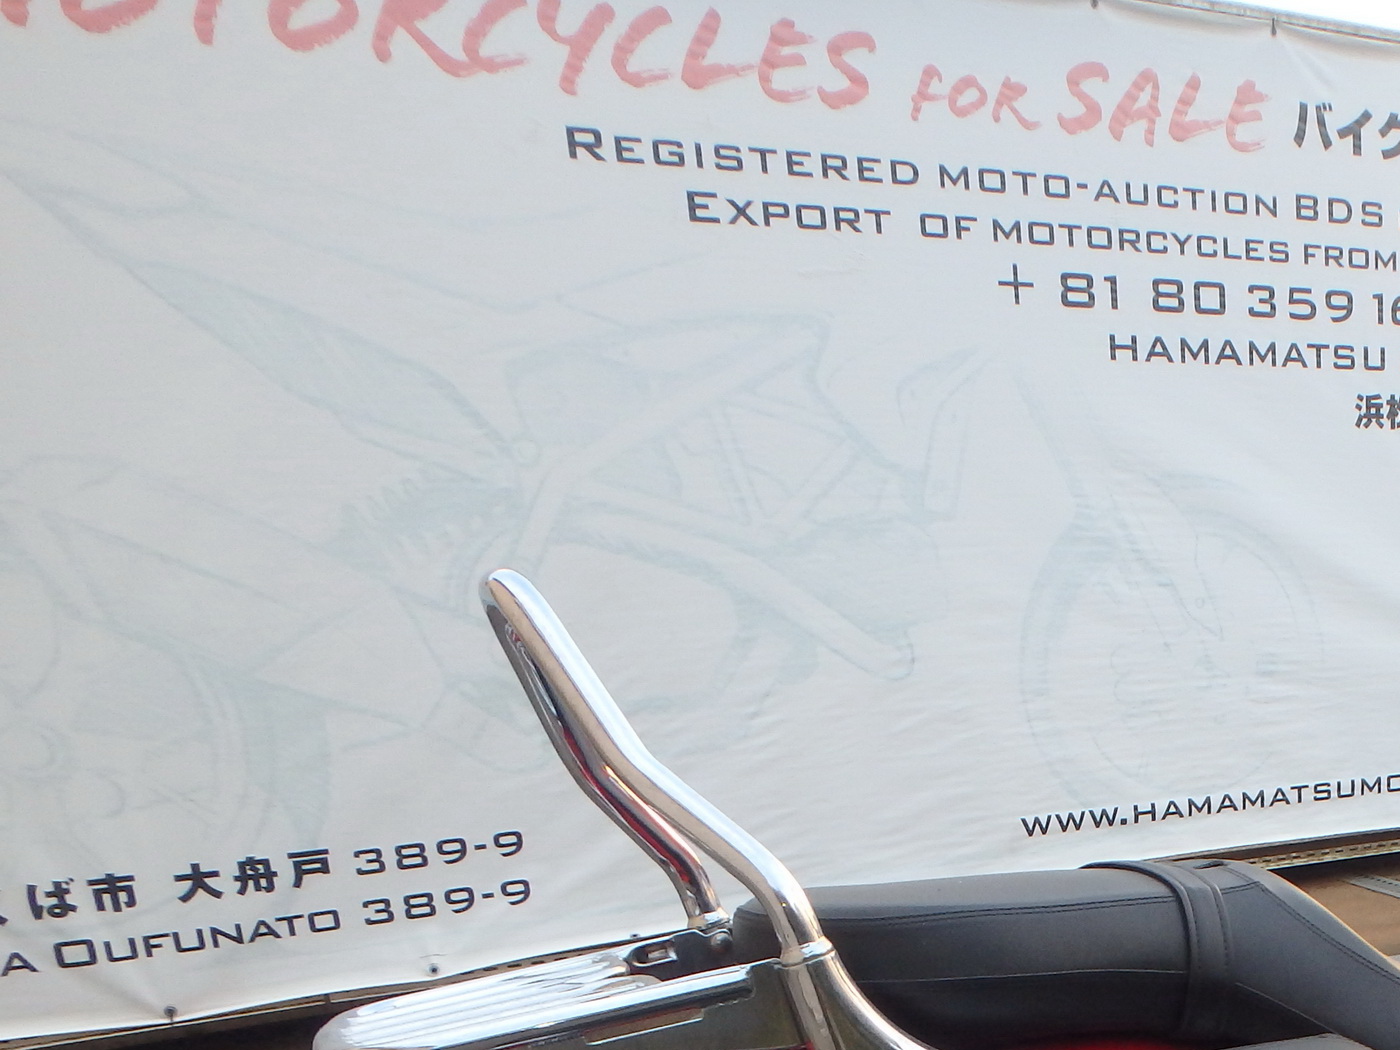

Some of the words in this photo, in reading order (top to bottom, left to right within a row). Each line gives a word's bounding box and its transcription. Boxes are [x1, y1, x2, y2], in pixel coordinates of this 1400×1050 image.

[1056, 61, 1272, 153] SALE
[565, 125, 920, 186] REGISTERED
[938, 163, 1278, 219] MOTO-AUCTION
[1295, 193, 1384, 228] BDS
[686, 189, 892, 235] EXPORT
[919, 212, 978, 241] OF
[991, 218, 1290, 267] MOTORCYCLES
[1303, 243, 1397, 273] FROM
[1059, 271, 1119, 311] 81
[1151, 277, 1227, 316] 80
[1247, 284, 1354, 324] 359
[1108, 333, 1386, 372] HAMAMATSU
[0, 872, 138, 926] ば市
[172, 848, 331, 904] 大舟戸
[352, 830, 524, 876] 389-9
[52, 909, 341, 969] OUFUNATO
[361, 878, 531, 926] 389-9
